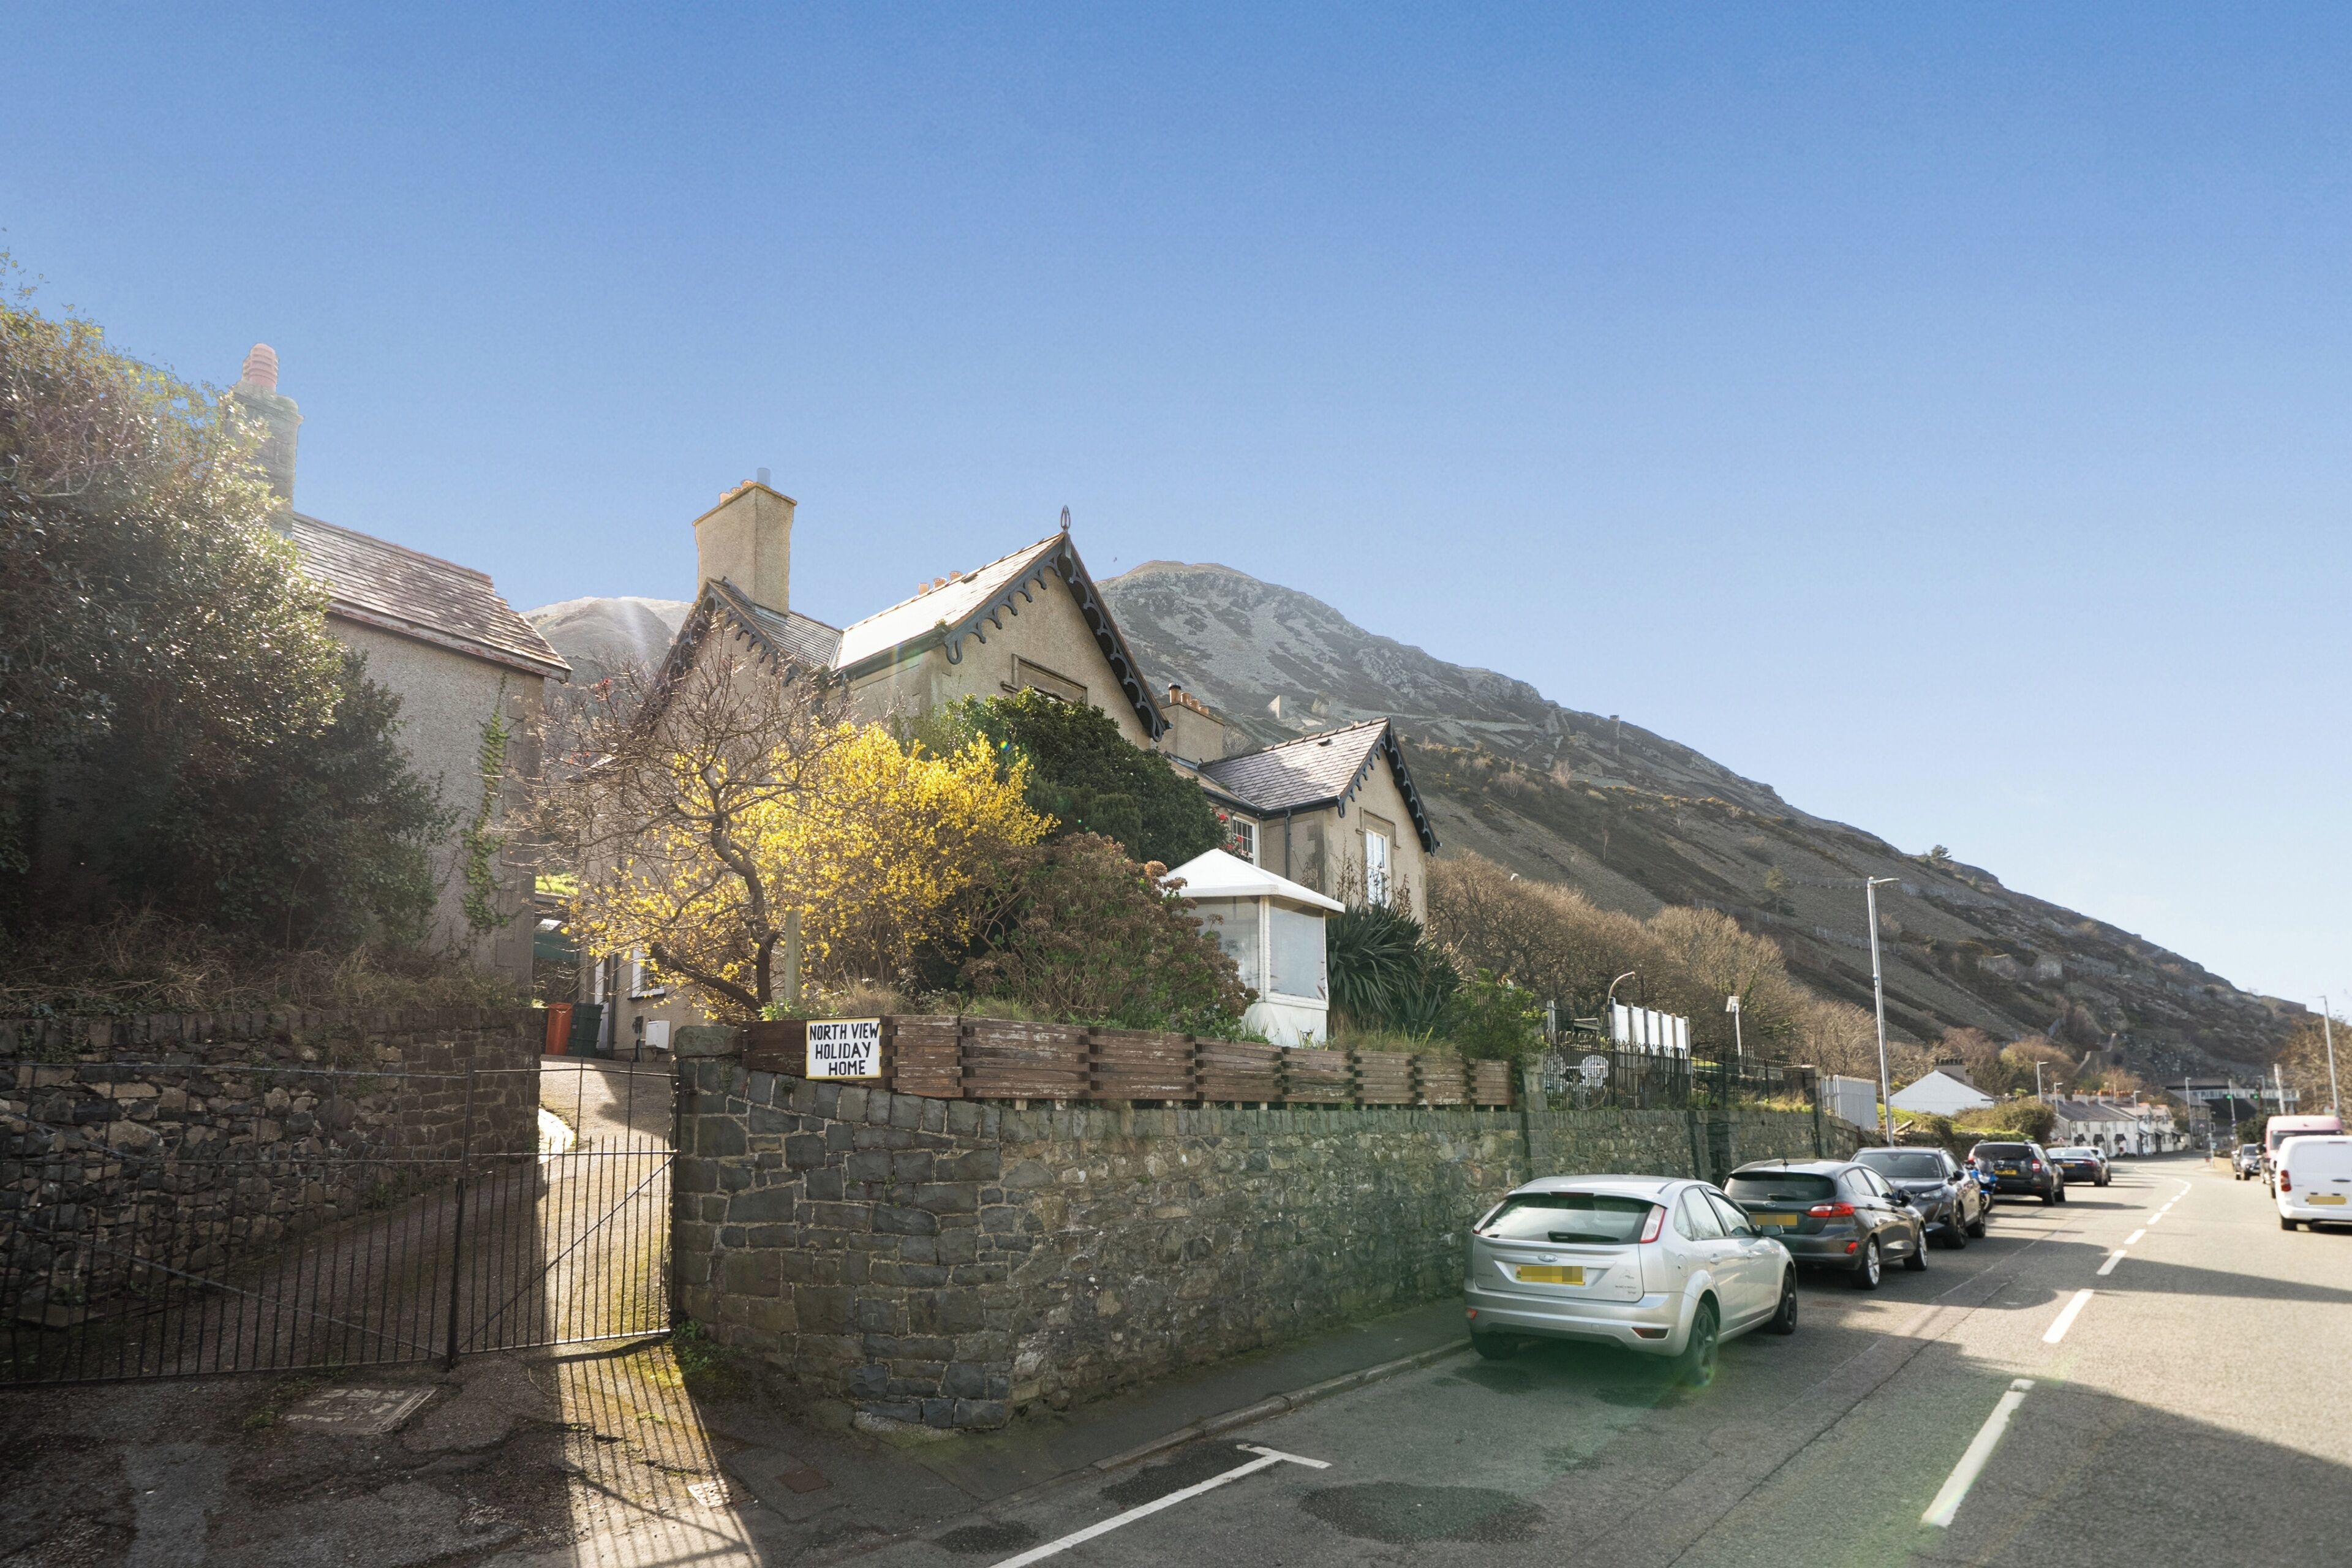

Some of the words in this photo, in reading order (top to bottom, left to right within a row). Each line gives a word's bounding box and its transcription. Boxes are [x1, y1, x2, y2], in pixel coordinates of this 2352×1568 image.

[810, 1023, 847, 1041] NORTH
[851, 1022, 880, 1039] VIEW
[815, 1042, 871, 1060] HOLIDAY
[829, 1060, 865, 1076] HOME
